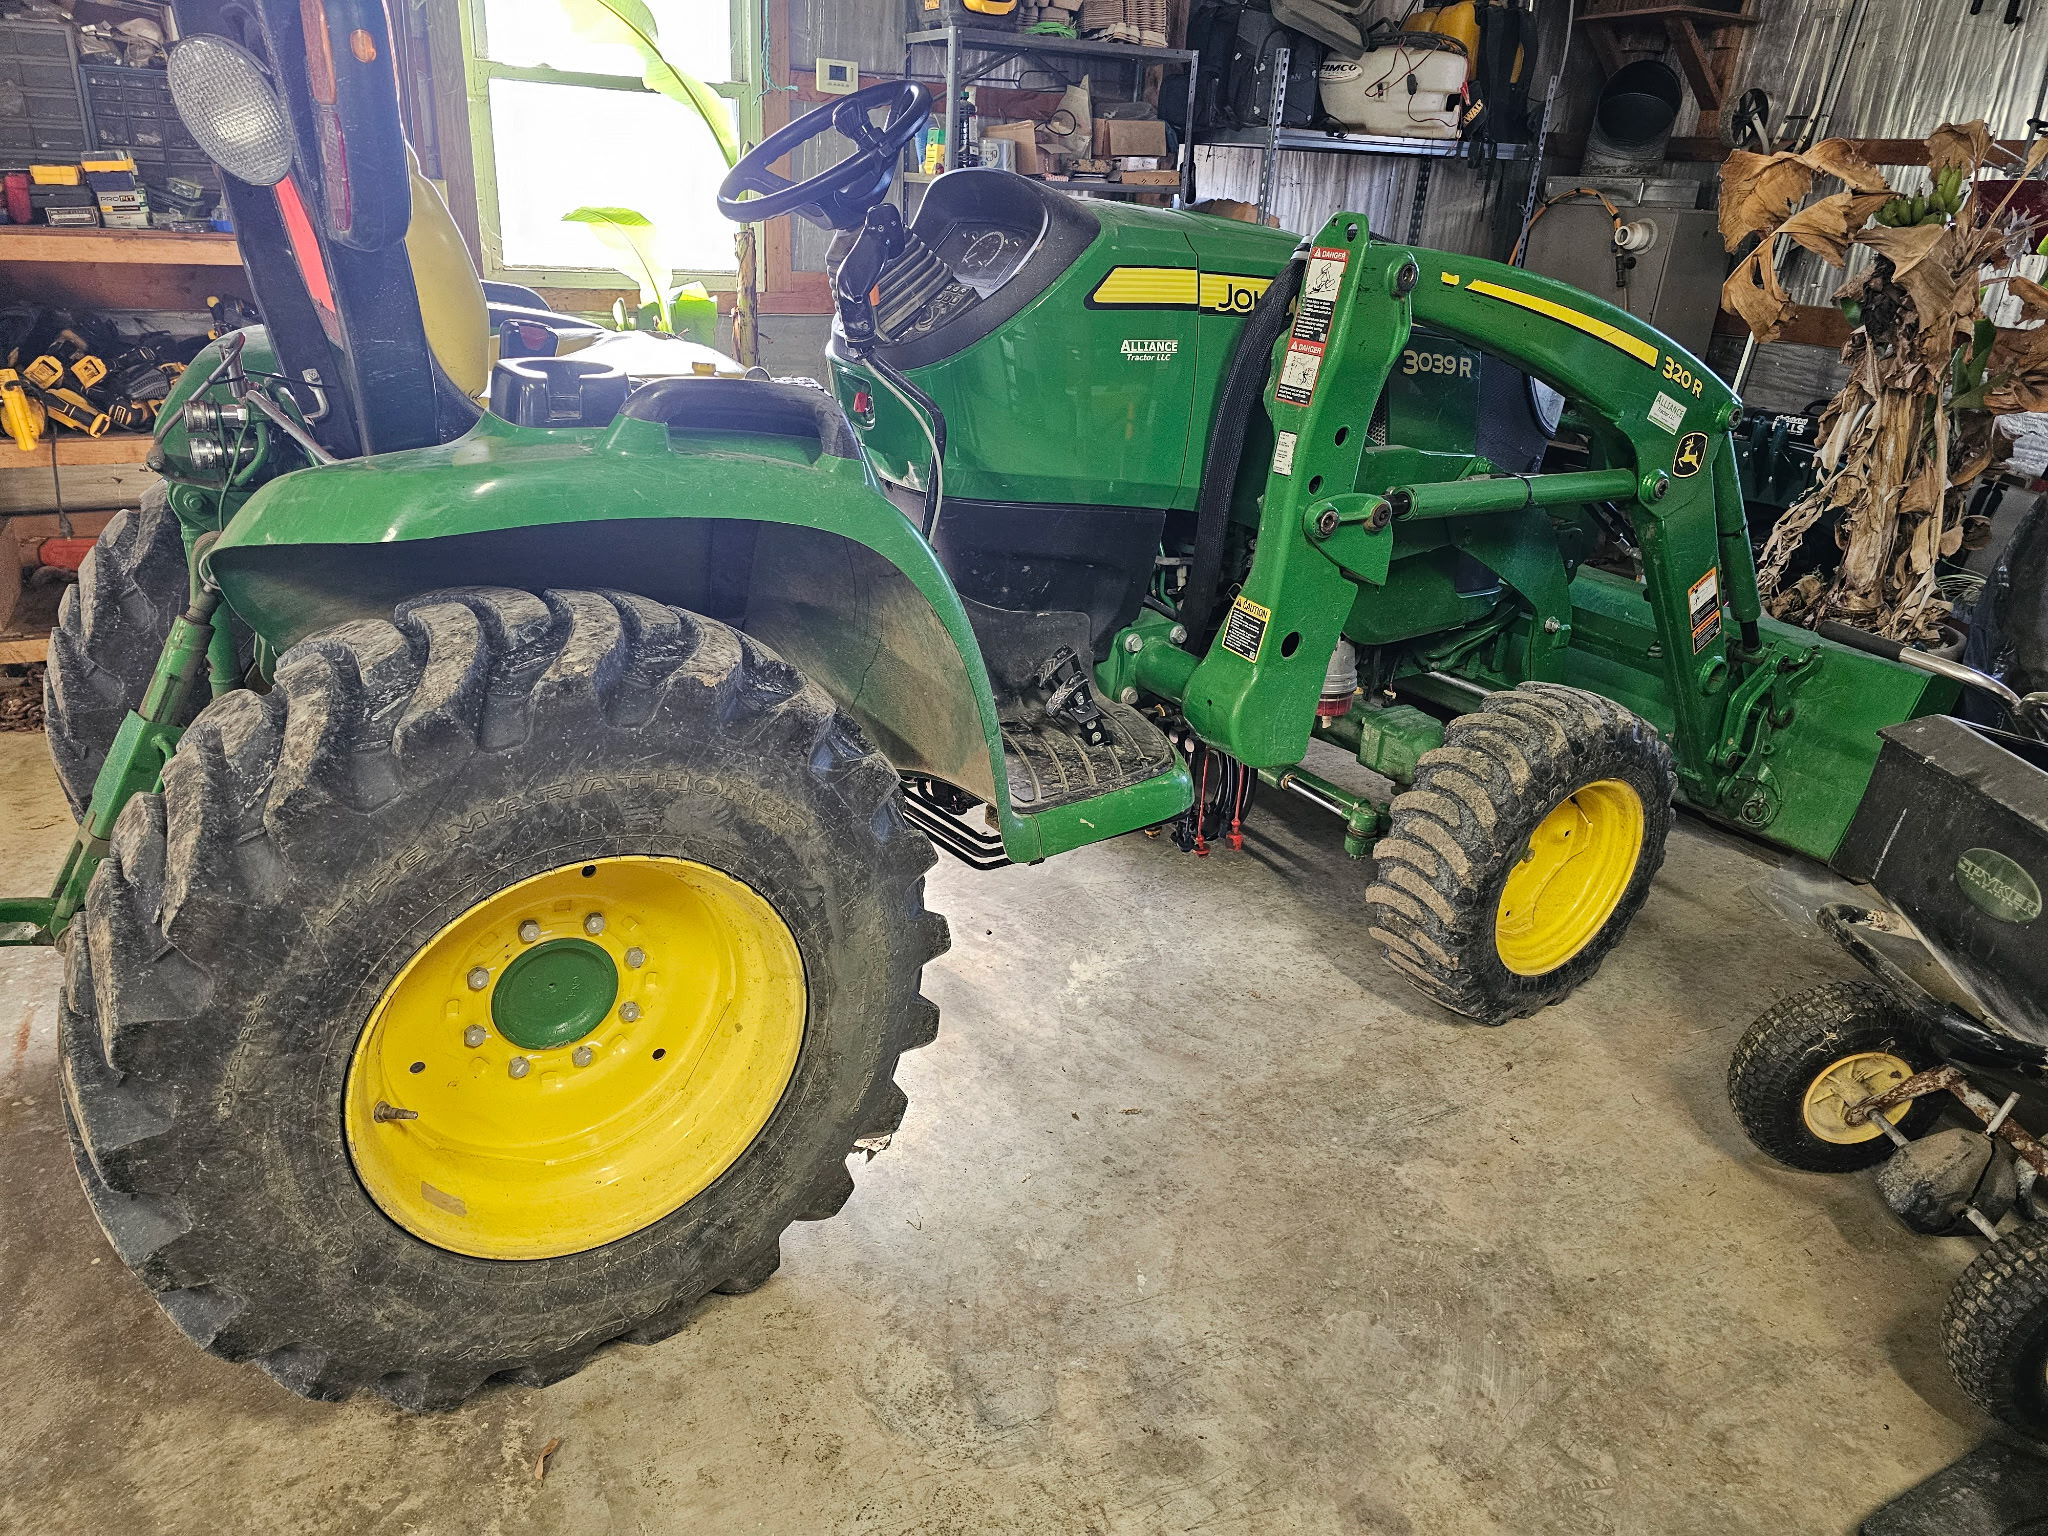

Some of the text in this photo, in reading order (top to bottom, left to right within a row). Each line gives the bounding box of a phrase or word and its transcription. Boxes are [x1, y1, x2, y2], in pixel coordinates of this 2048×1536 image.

[1320, 63, 1358, 72] FIMCO
[1321, 249, 1346, 260] DANGER
[1120, 339, 1179, 353] ALLIANCE
[1298, 343, 1322, 354] DANGER
[1126, 353, 1171, 361] Tractor LLC
[1655, 394, 1685, 418] ALLIANCE
[1243, 600, 1268, 618] CAUTION
